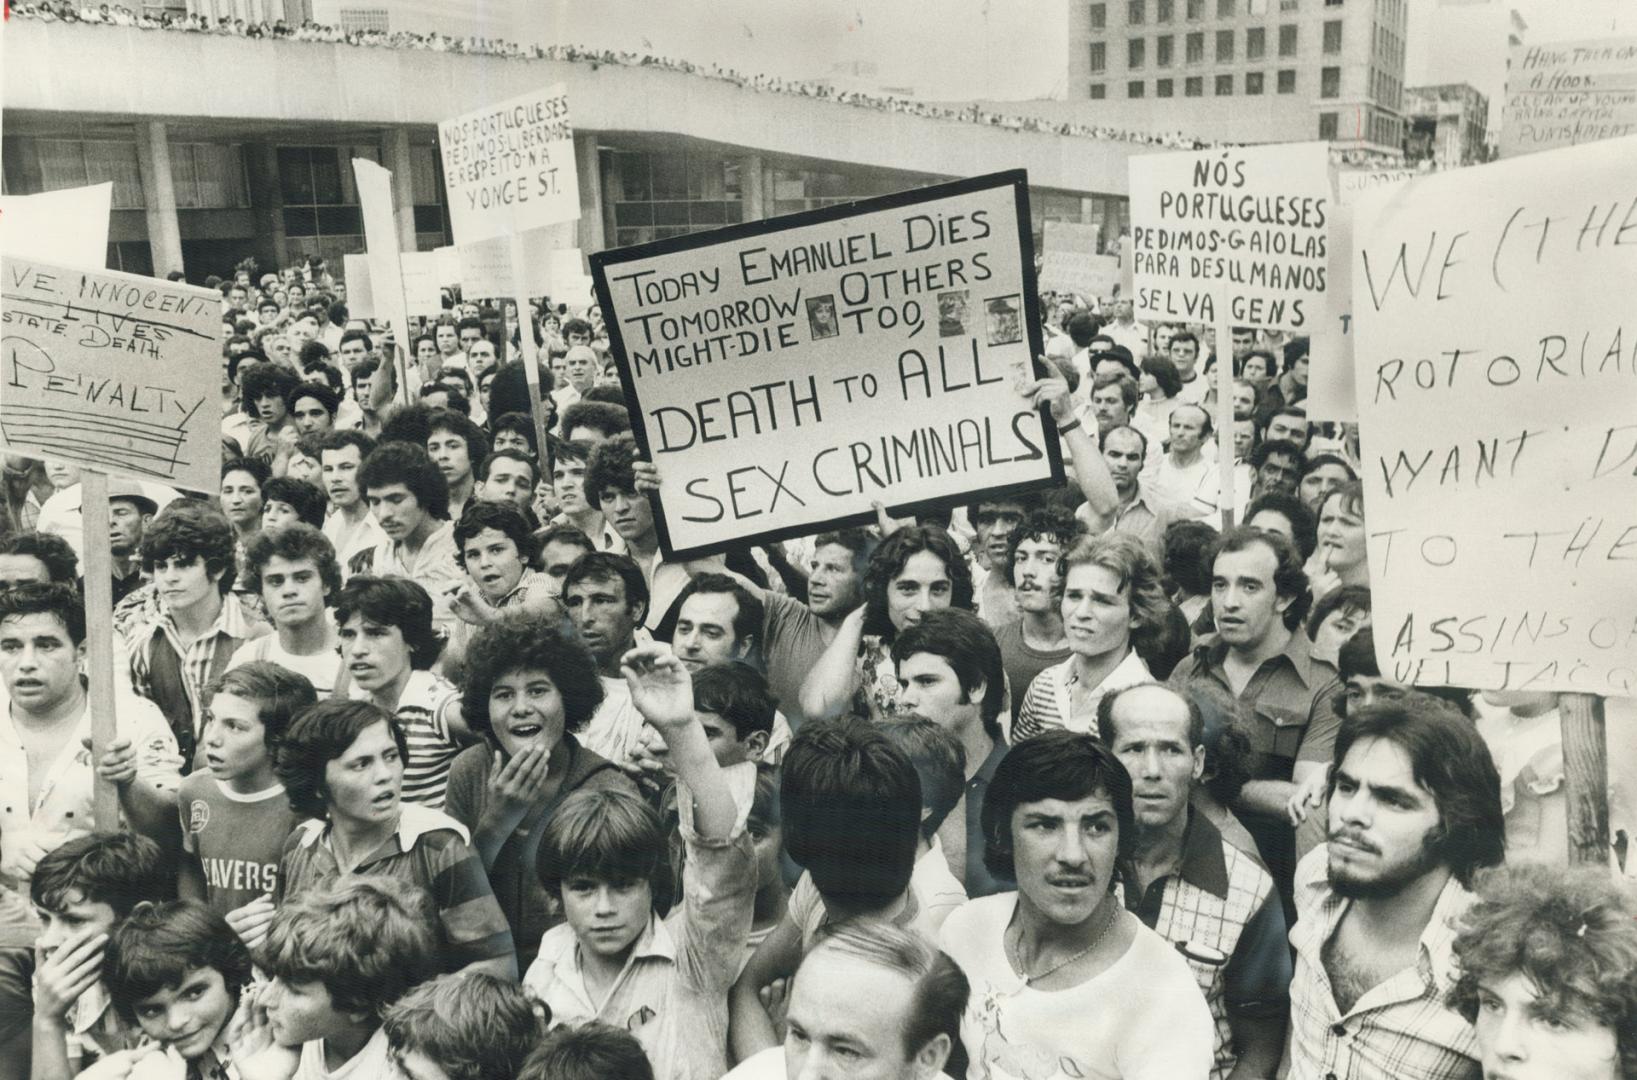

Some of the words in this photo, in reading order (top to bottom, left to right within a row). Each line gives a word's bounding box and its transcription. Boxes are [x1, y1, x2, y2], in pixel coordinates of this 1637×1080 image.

[1530, 71, 1544, 89] A
[466, 176, 529, 210] YONGE
[537, 167, 561, 197] ST.
[1193, 152, 1246, 188] NÓS
[1160, 191, 1326, 229] PORTUGUESES
[612, 268, 720, 307] TODAY
[739, 232, 892, 286] EMANUEL
[1134, 252, 1179, 278] PARA
[1191, 256, 1326, 293] DESUMANOS
[1362, 231, 1470, 311] WE
[63, 300, 174, 341] LIVES
[625, 288, 802, 345] TOMORROW
[840, 252, 993, 306] OTHERS
[1138, 287, 1215, 323] SELVA
[1231, 296, 1305, 327] GENS
[633, 323, 799, 378] MIGHT-DIE
[1374, 326, 1637, 404] ROTORIA
[650, 375, 822, 454] DEATH
[833, 373, 878, 403] TO
[898, 338, 1004, 401] ALL
[682, 460, 806, 523] SEX
[812, 411, 1044, 497] CRIMINALS
[1371, 528, 1458, 577] TO
